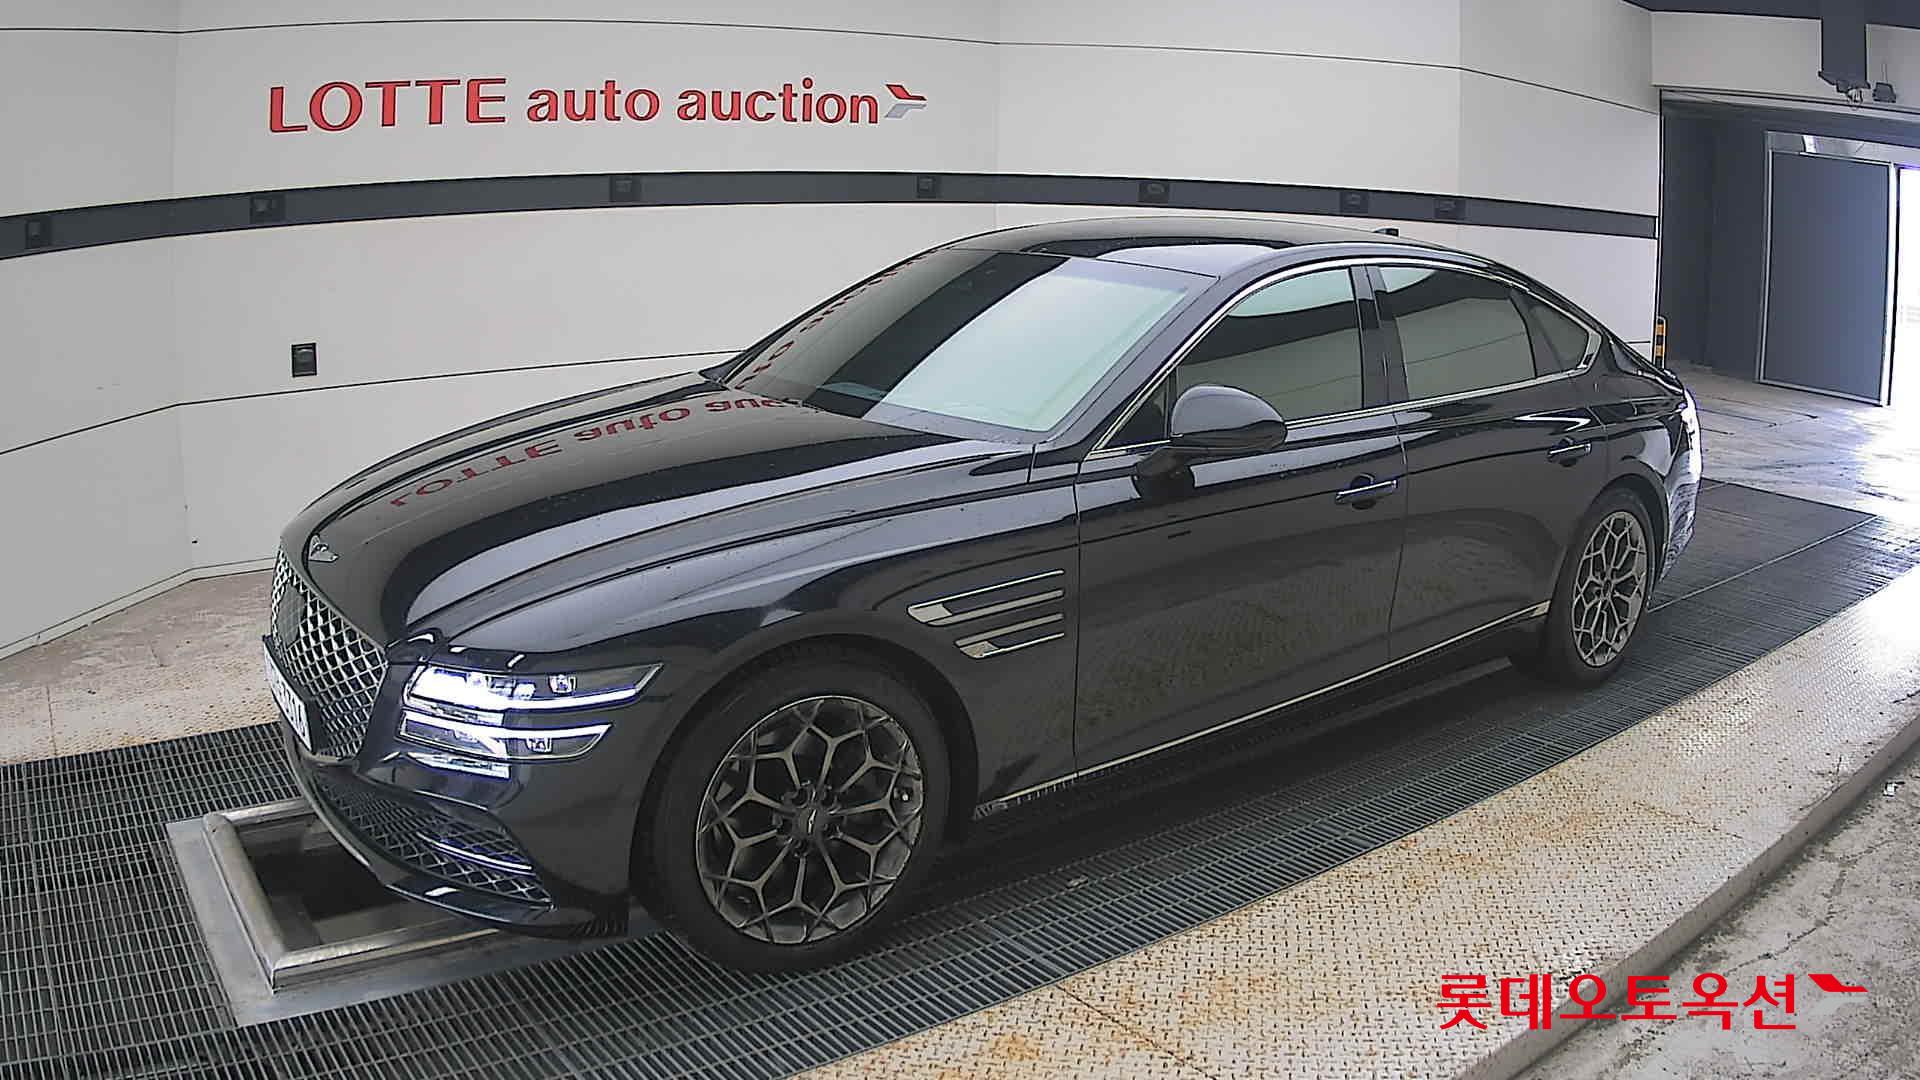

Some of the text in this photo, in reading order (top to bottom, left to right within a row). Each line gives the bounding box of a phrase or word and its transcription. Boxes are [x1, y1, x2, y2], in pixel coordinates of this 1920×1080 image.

[269, 78, 880, 132] LOTTE auto auction
